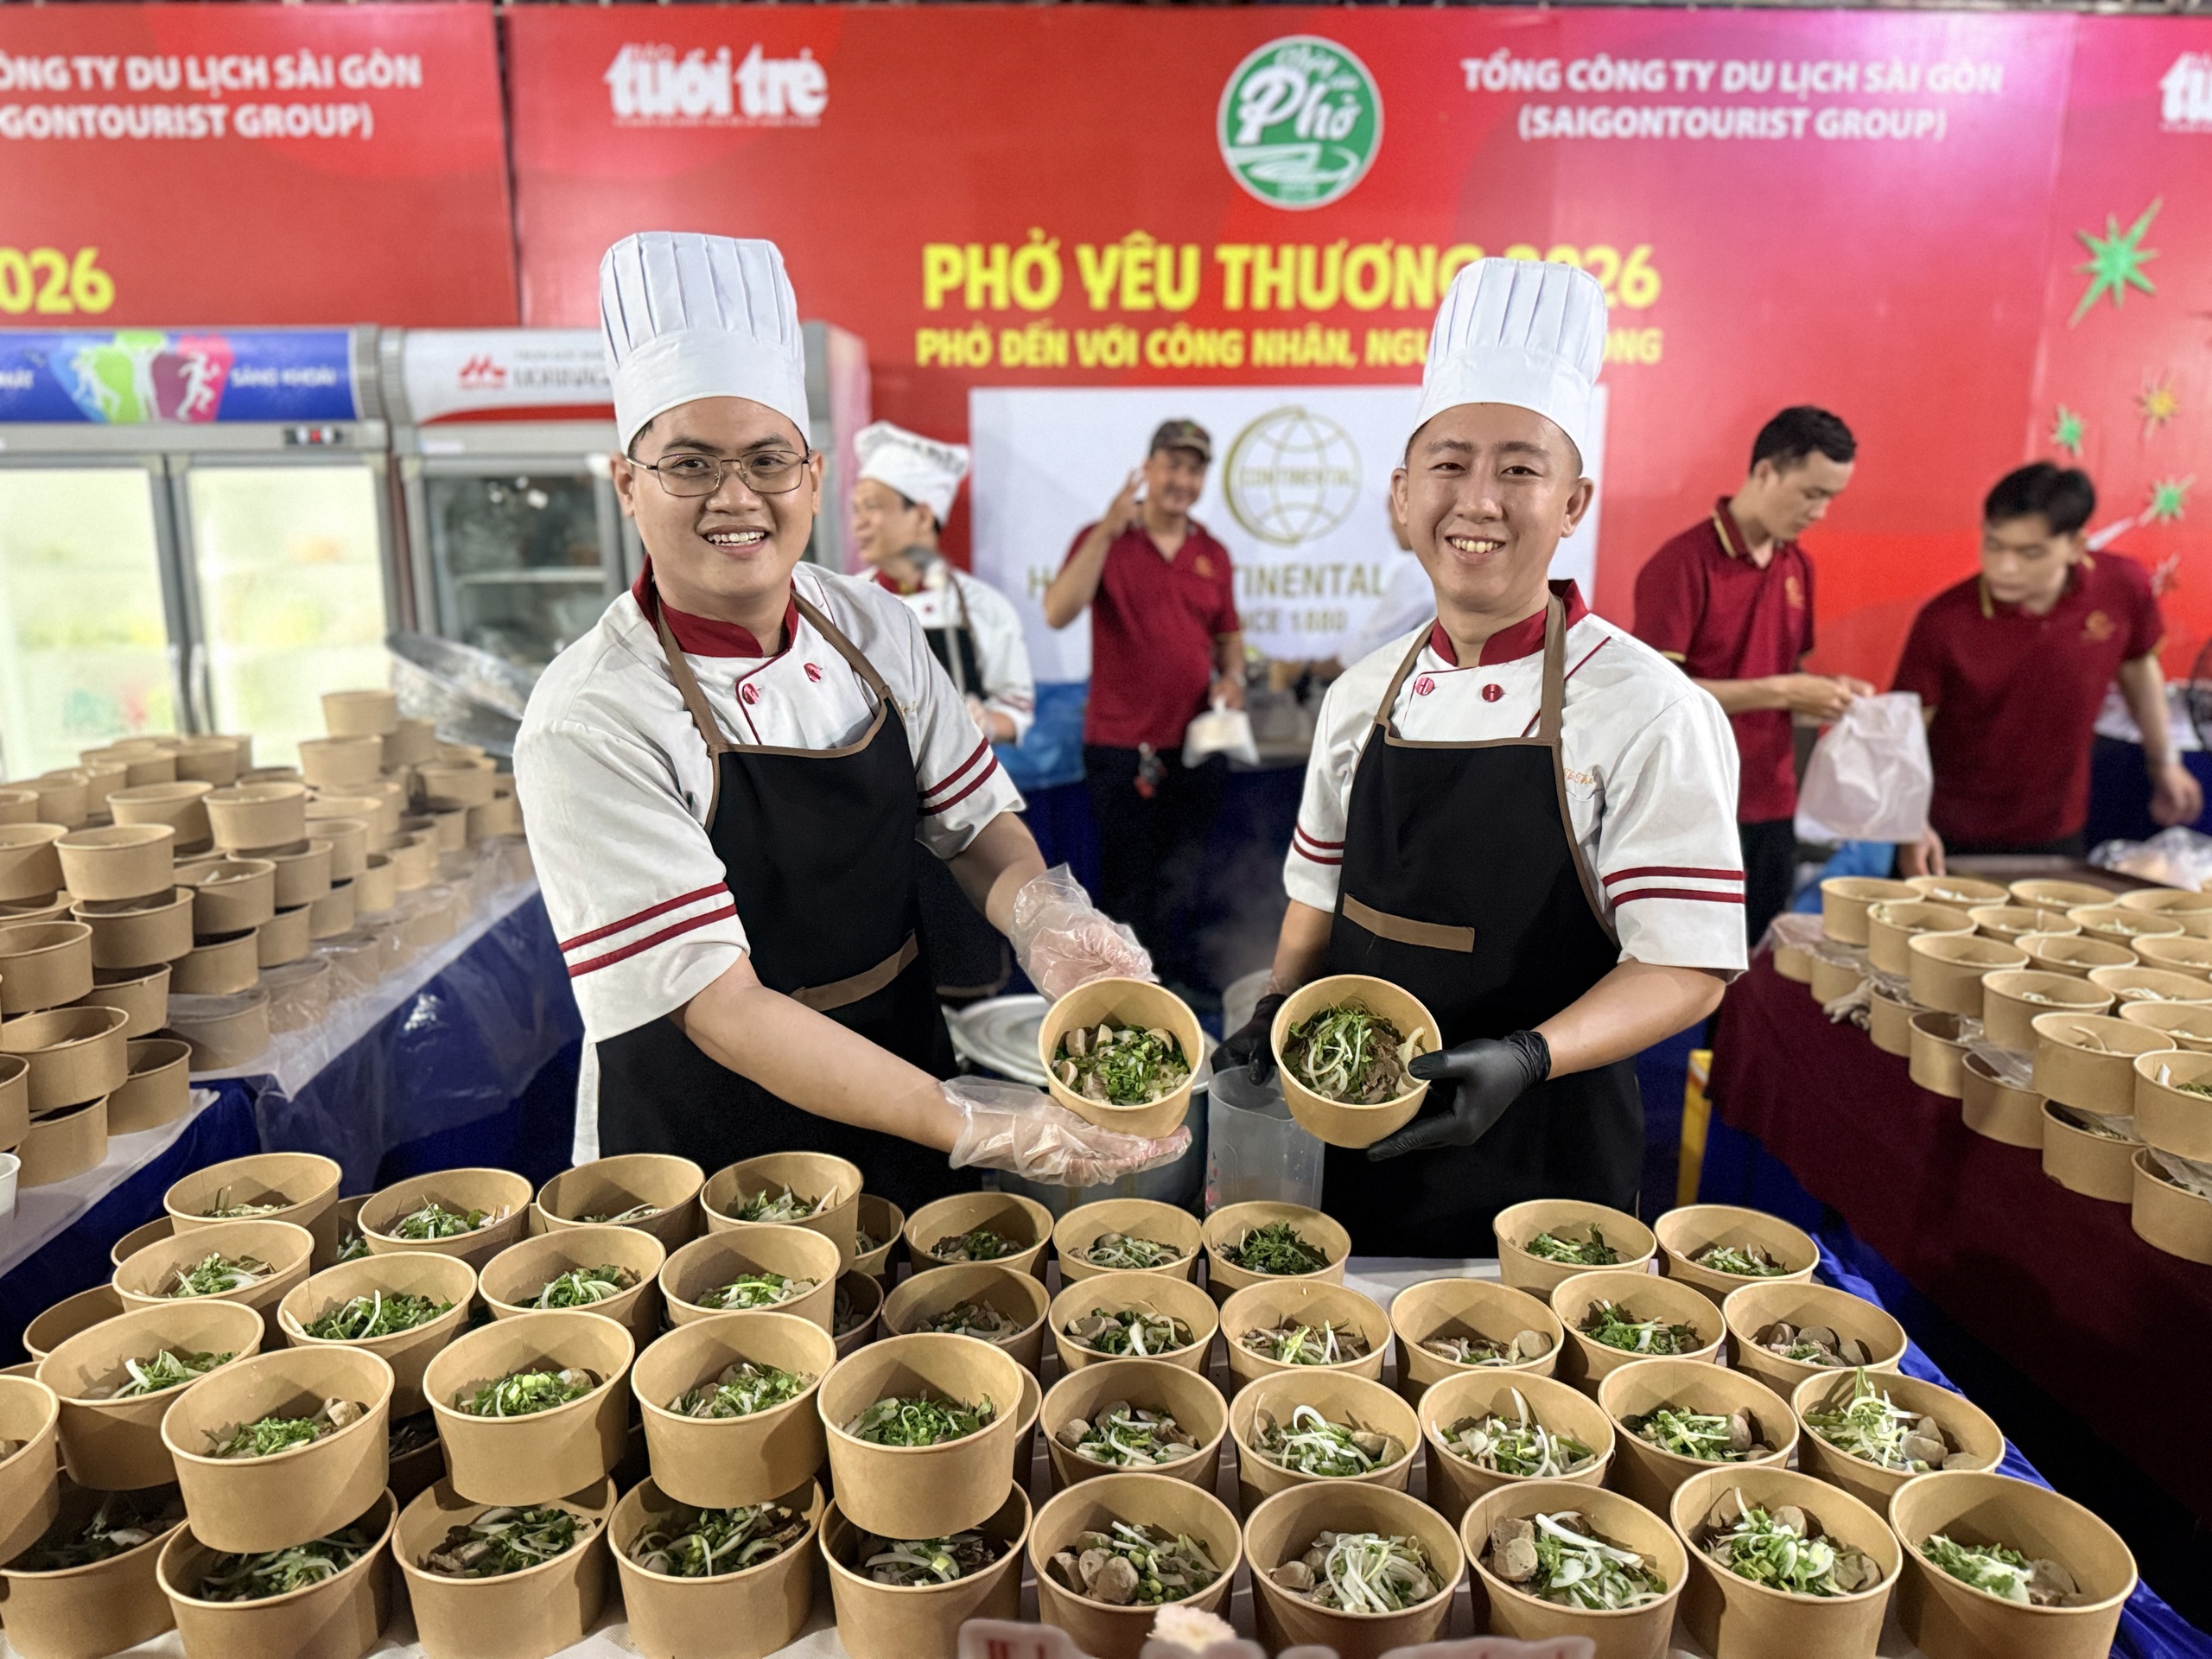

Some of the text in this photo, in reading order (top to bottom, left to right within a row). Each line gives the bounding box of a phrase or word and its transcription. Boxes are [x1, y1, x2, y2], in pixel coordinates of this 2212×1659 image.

[71, 55, 121, 90] TY
[124, 55, 181, 91] DU
[184, 54, 270, 99] LỊCH
[273, 48, 335, 89] SÀI
[339, 47, 423, 88] GÒN
[734, 42, 829, 118] trẻ
[1460, 47, 2005, 102] TỔNG CÔNG TY DU LỊCH SÀI GÒN
[232, 101, 374, 140] GROUP)
[1236, 65, 1363, 145] Phở
[1518, 103, 1947, 143] (SAIGONTOURIST GROUP)
[922, 226, 1062, 310] PHỞ
[1075, 231, 1201, 310] YÊU
[1503, 244, 1662, 309] 26
[1144, 321, 1244, 367] CÔNG
[1250, 321, 1358, 369] NHÂN,
[1604, 328, 1664, 364] NG
[1234, 563, 1385, 598] INENTAL
